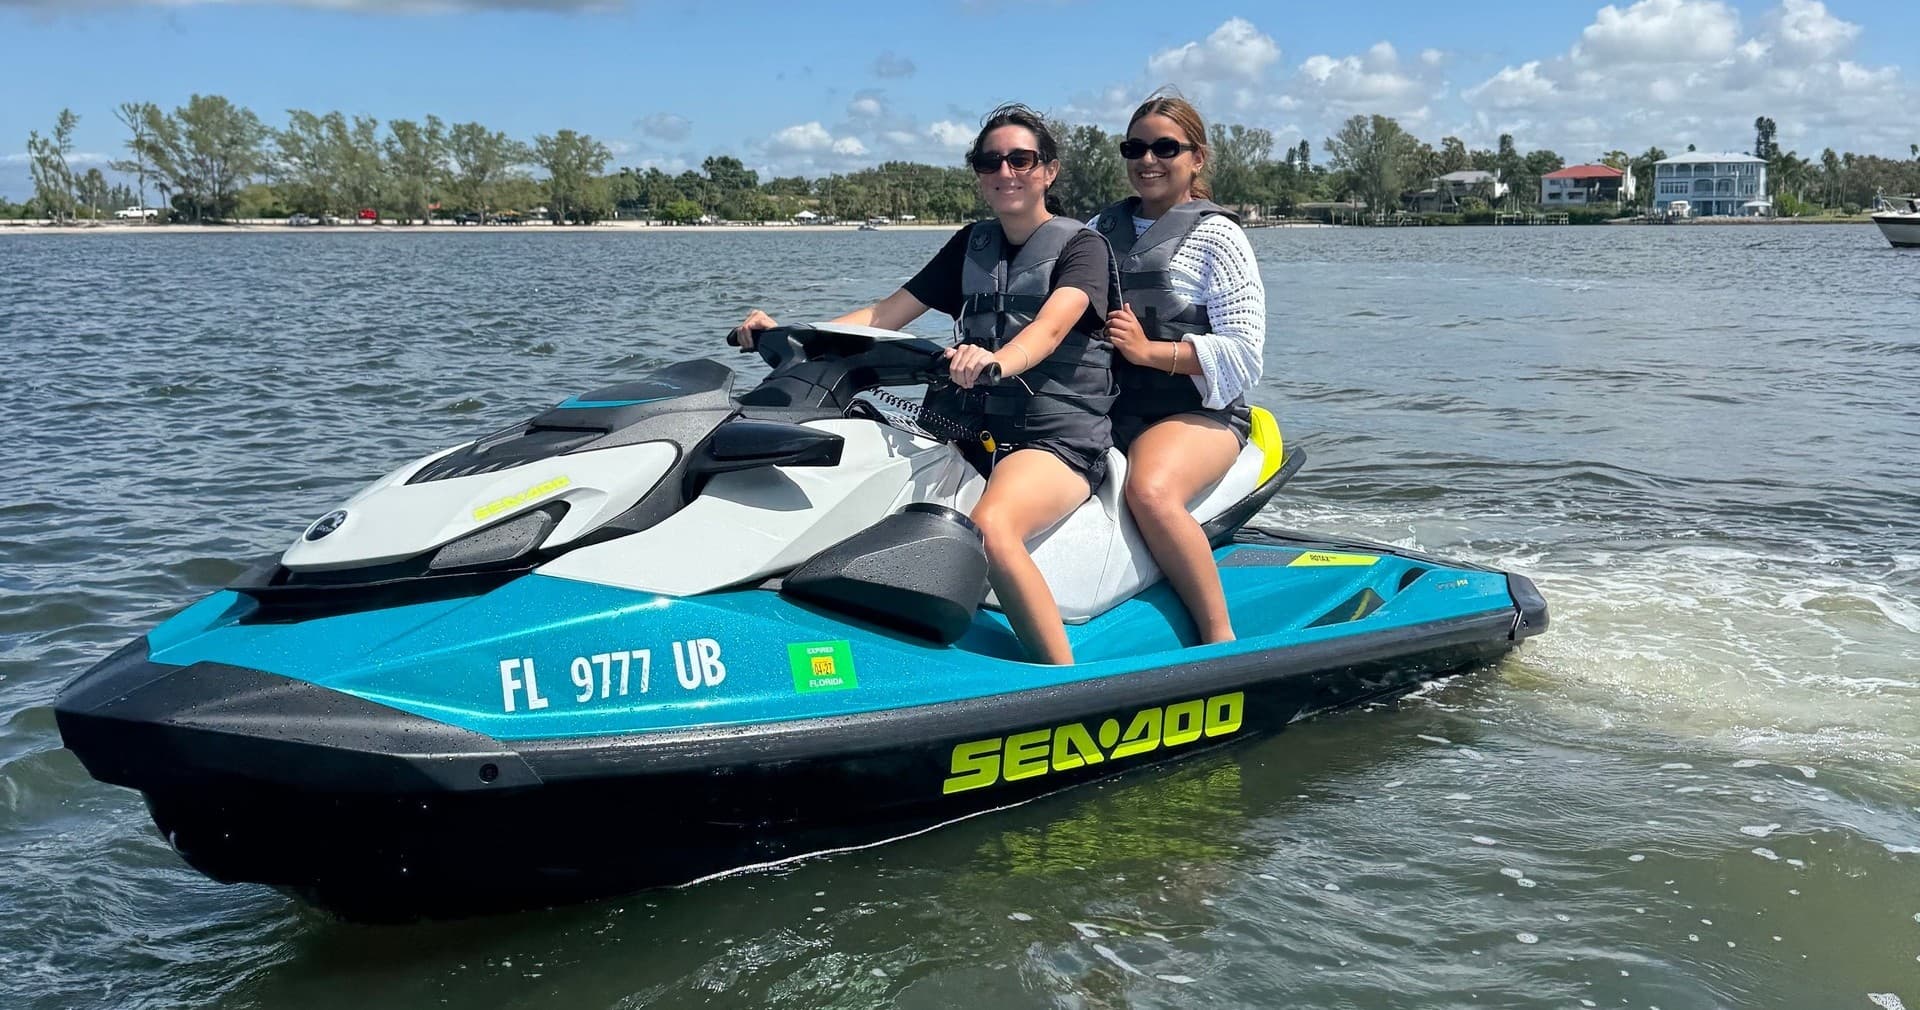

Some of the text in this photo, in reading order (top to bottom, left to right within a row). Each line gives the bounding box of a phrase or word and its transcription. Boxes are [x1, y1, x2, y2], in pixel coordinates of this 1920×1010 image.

[500, 638, 726, 712] FL 9777 UB
[809, 678, 843, 687] FLORIDA
